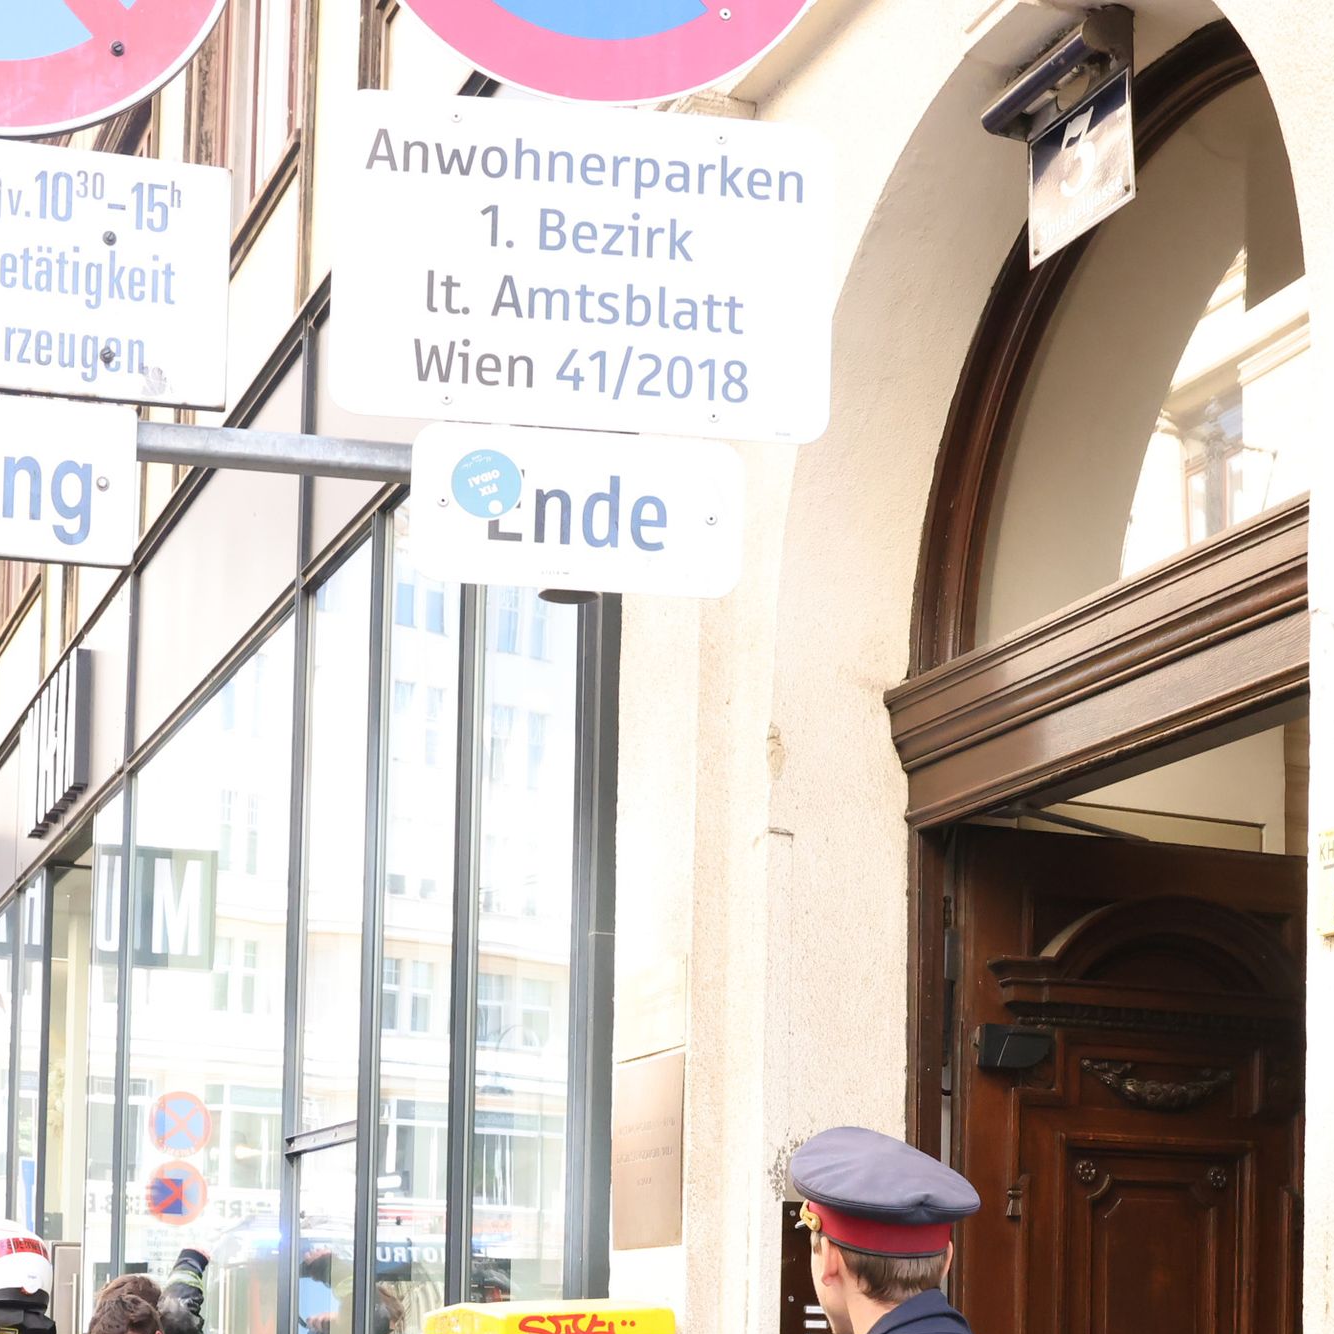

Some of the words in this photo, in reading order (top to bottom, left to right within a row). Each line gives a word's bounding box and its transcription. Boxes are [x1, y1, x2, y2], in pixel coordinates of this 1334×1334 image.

[365, 128, 805, 203] Anwohnerparken
[479, 204, 515, 249] 1.
[538, 207, 694, 262] Bezirk
[424, 269, 471, 316] lt.
[492, 274, 744, 335] Amtsblatt
[413, 338, 535, 388] Wien
[555, 345, 750, 404] 41/2018
[487, 474, 668, 551] nde
